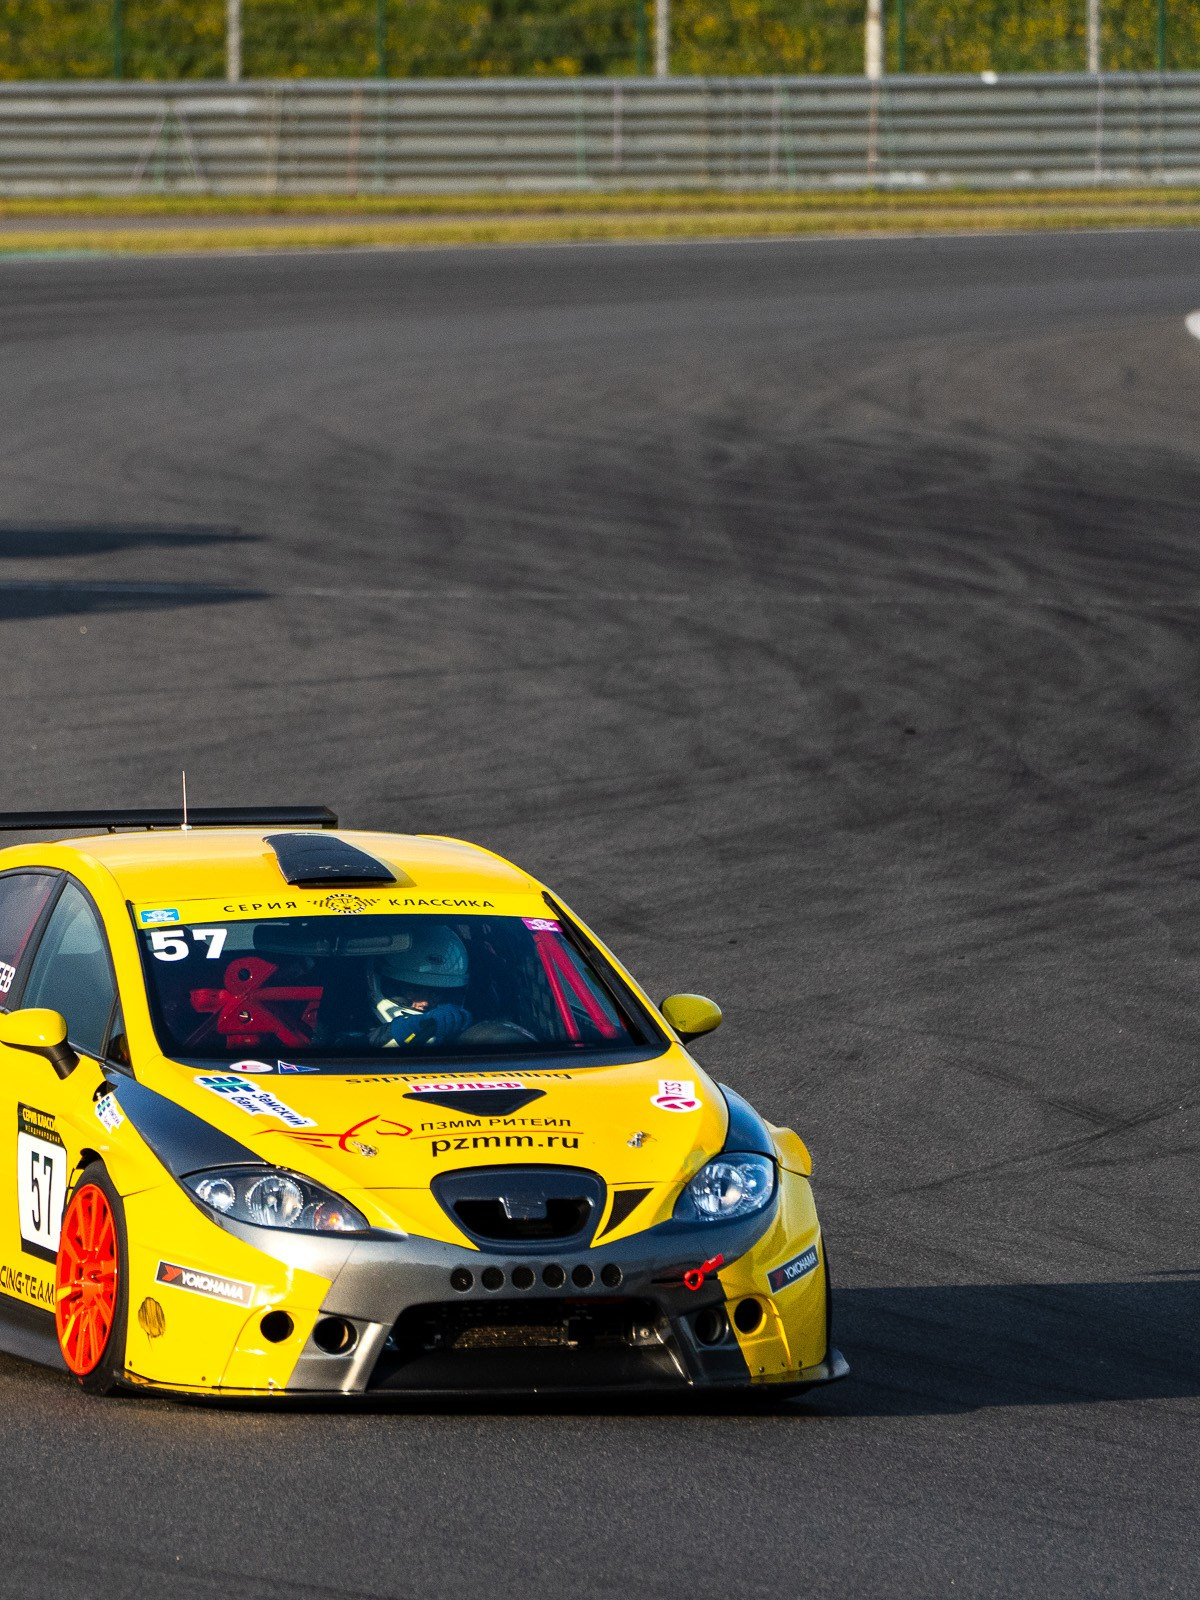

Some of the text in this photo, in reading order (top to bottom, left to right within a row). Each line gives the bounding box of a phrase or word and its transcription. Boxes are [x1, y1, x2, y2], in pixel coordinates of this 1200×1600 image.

[223, 898, 495, 913] СЕРИЯ КЛАССИКА
[150, 928, 228, 962] 57
[411, 1082, 521, 1092] РОЛЬФ
[420, 1117, 572, 1131] ПЗММ РИТЕЙЛ
[431, 1135, 579, 1157] pzmm.ru
[31, 1150, 54, 1236] 57
[784, 1251, 817, 1280] YOKOHAMA
[182, 1269, 244, 1300] YOKOHAMA
